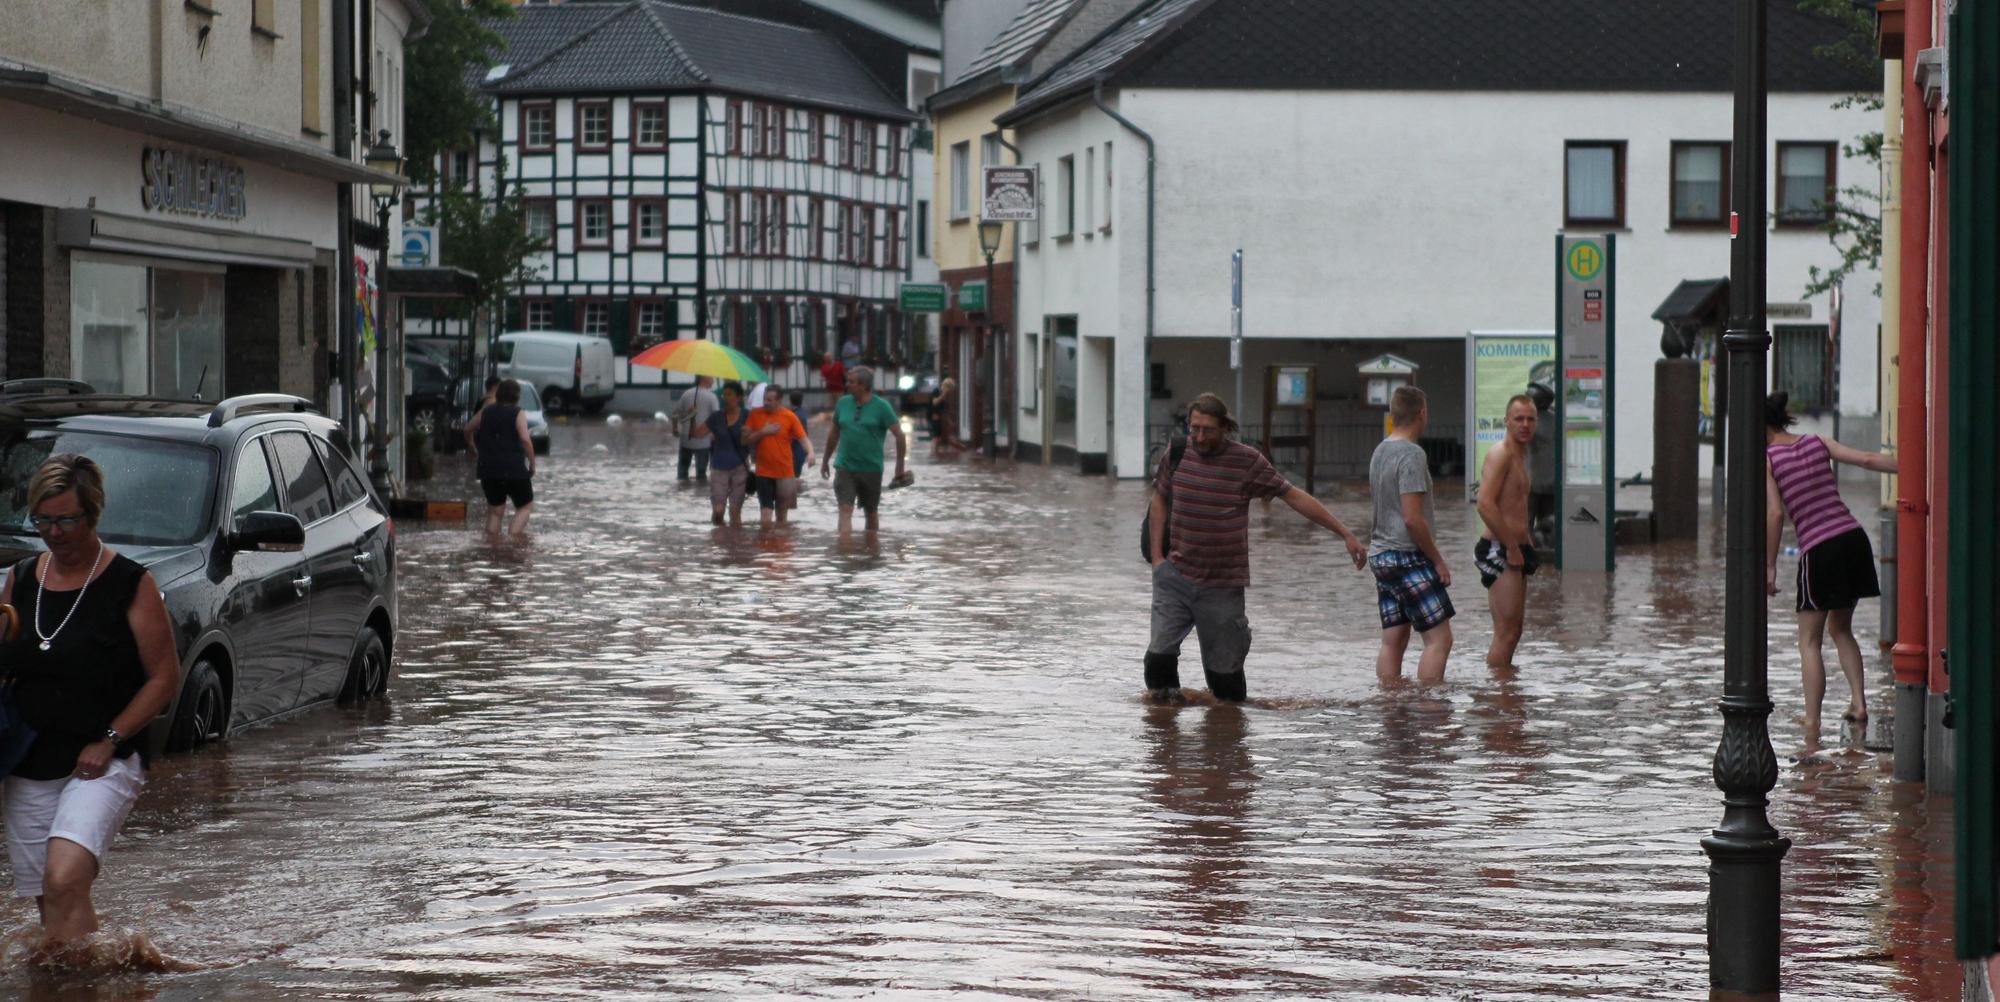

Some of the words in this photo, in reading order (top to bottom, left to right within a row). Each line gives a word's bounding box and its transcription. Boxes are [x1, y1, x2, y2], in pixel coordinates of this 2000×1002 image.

[142, 147, 246, 218] SCHLECKER
[1577, 247, 1593, 273] H
[1476, 343, 1551, 358] KOMMERN
